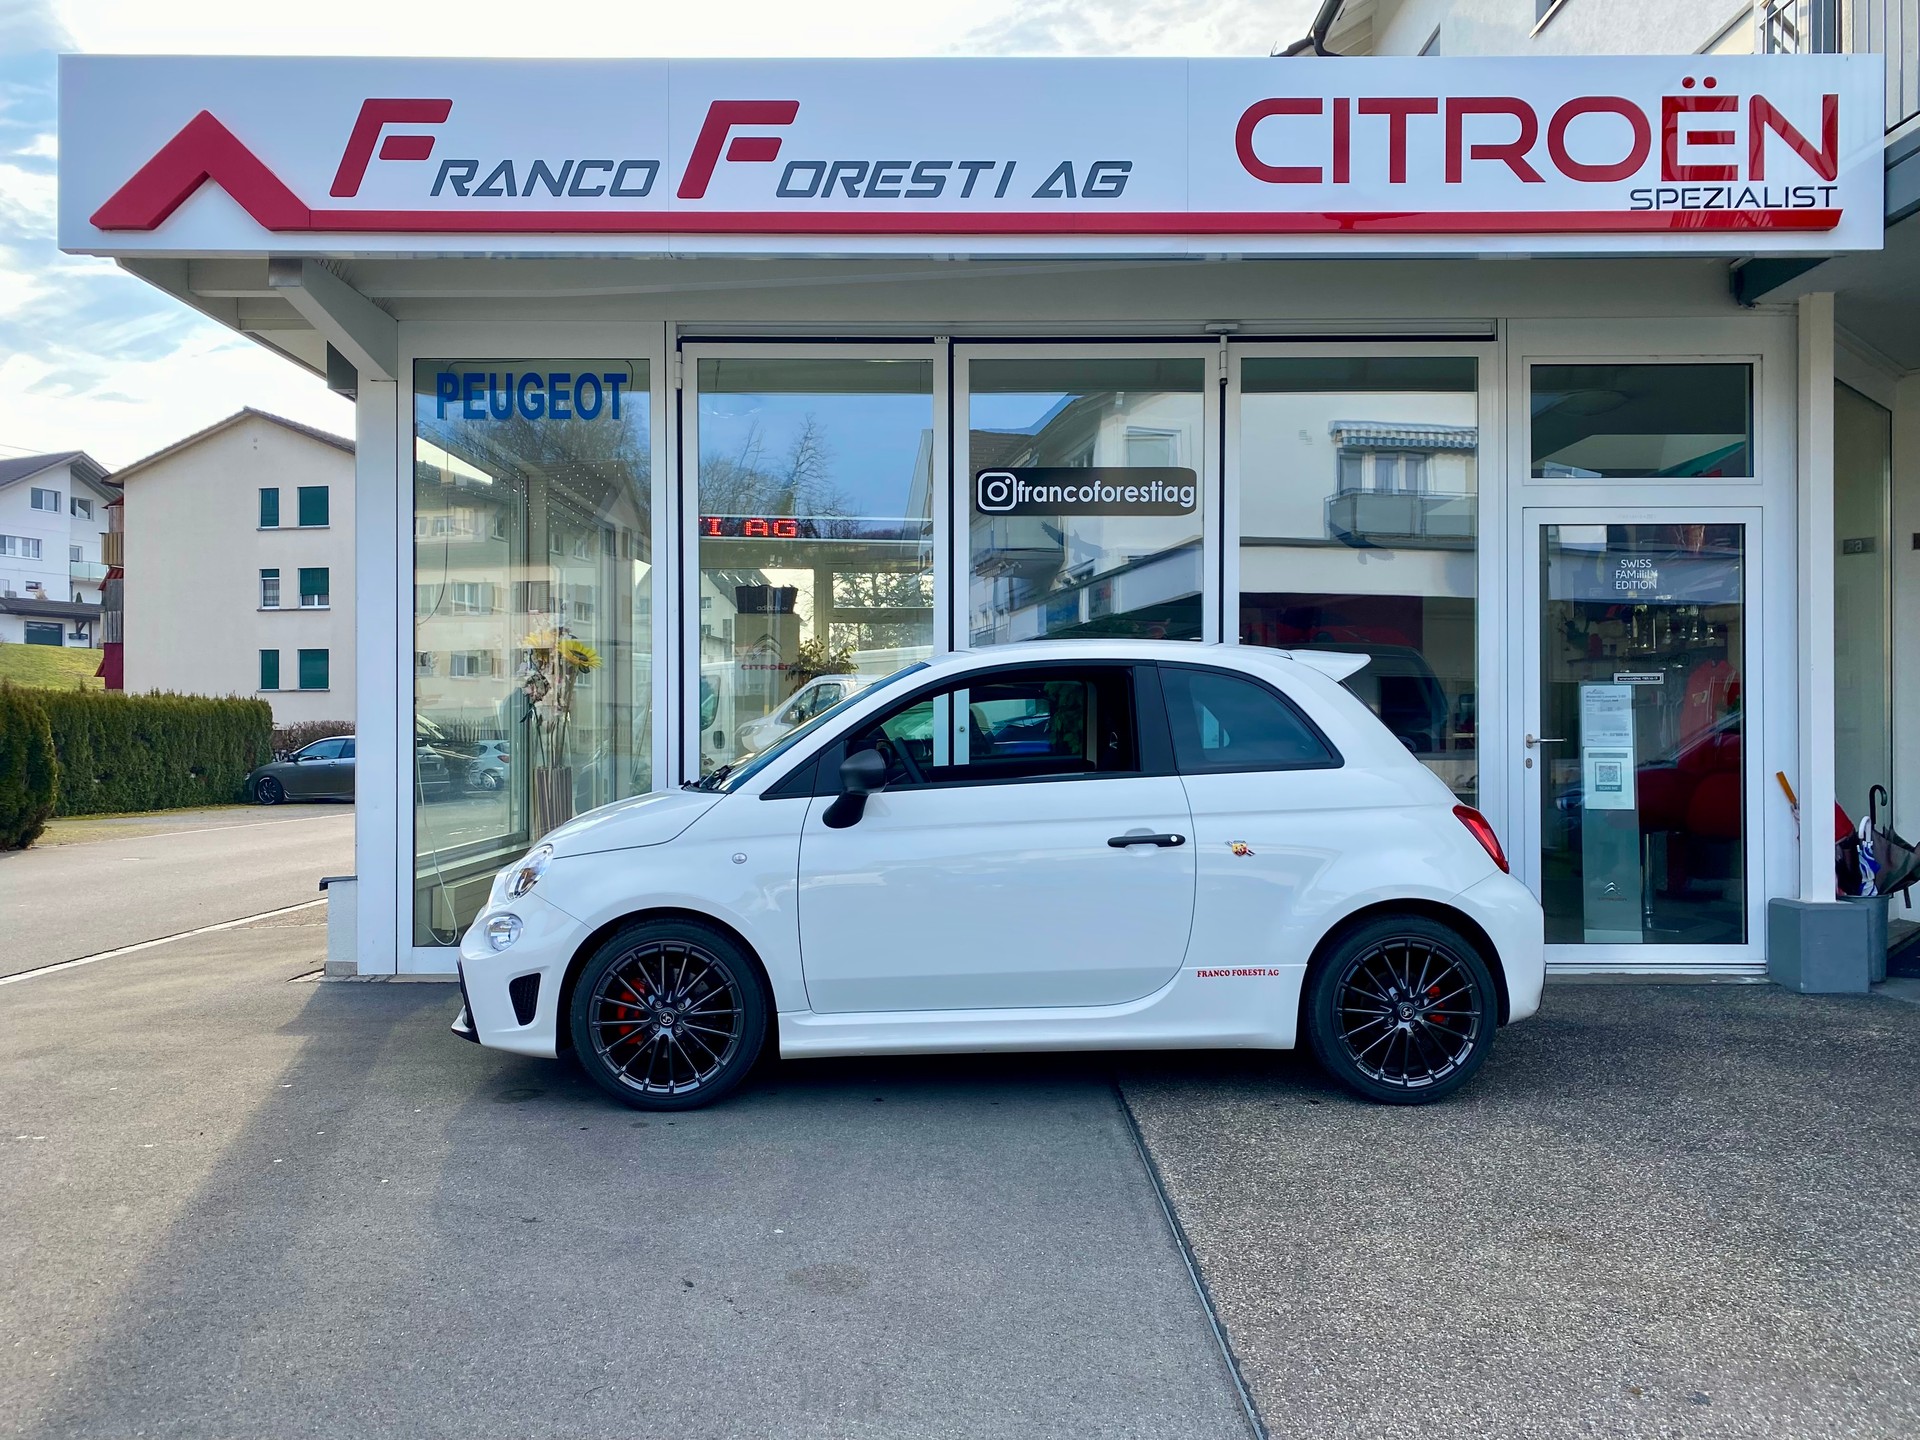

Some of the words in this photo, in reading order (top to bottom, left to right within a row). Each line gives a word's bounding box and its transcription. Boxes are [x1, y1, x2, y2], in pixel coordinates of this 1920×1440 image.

[1235, 76, 1840, 184] CITROËN
[329, 98, 661, 198] FRANCO
[677, 100, 1017, 199] FORESTI
[1031, 160, 1134, 199] AG
[1630, 186, 1838, 211] SPEZIALIST
[436, 372, 628, 421] PEUGEOT
[1017, 480, 1195, 508] francoforestiag
[744, 518, 797, 537] AG
[1620, 559, 1652, 569] SWISS
[1615, 580, 1657, 590] EDITION
[1197, 969, 1231, 978] FRANCO
[1232, 968, 1266, 977] FORESTI
[1267, 969, 1280, 977] AG
